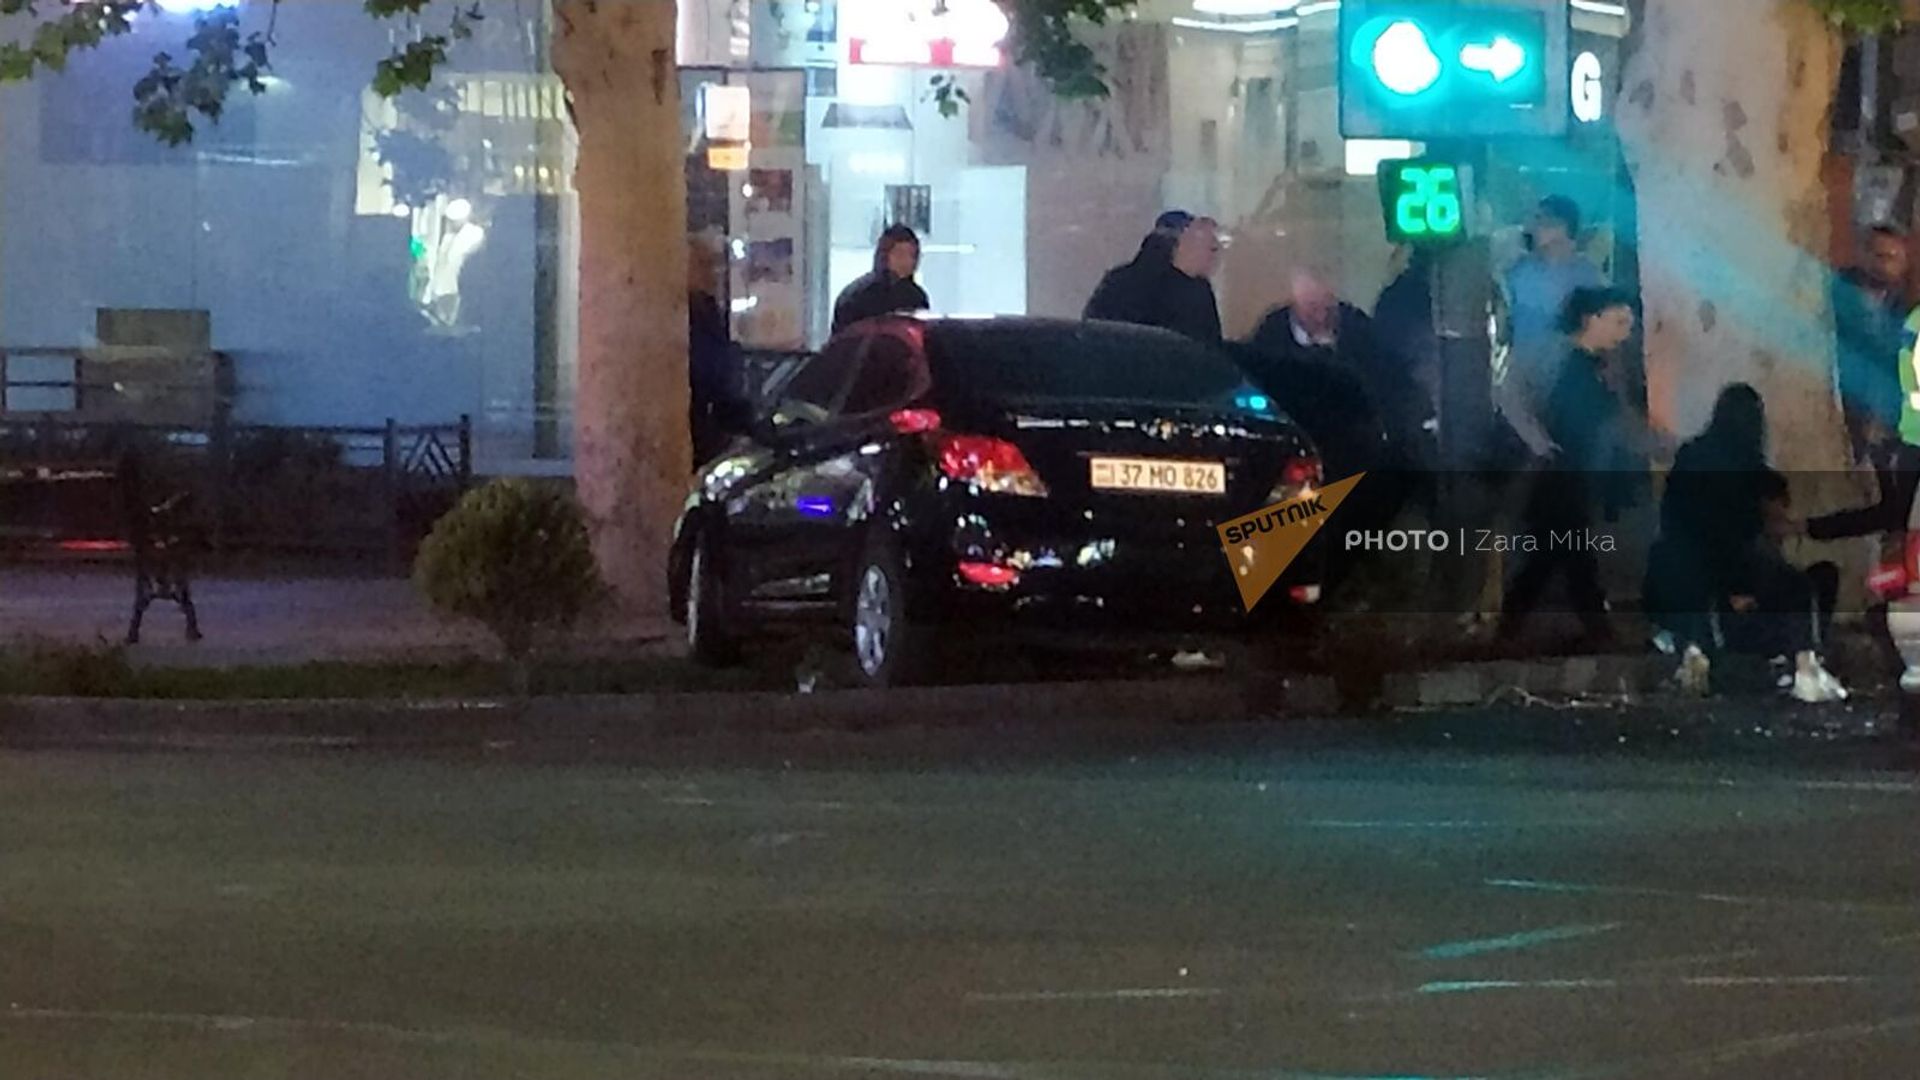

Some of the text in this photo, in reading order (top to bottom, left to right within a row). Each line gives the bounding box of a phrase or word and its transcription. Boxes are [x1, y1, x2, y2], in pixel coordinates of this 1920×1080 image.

[1397, 167, 1460, 233] 26
[1120, 464, 1142, 486] 37
[1183, 467, 1217, 489] 826
